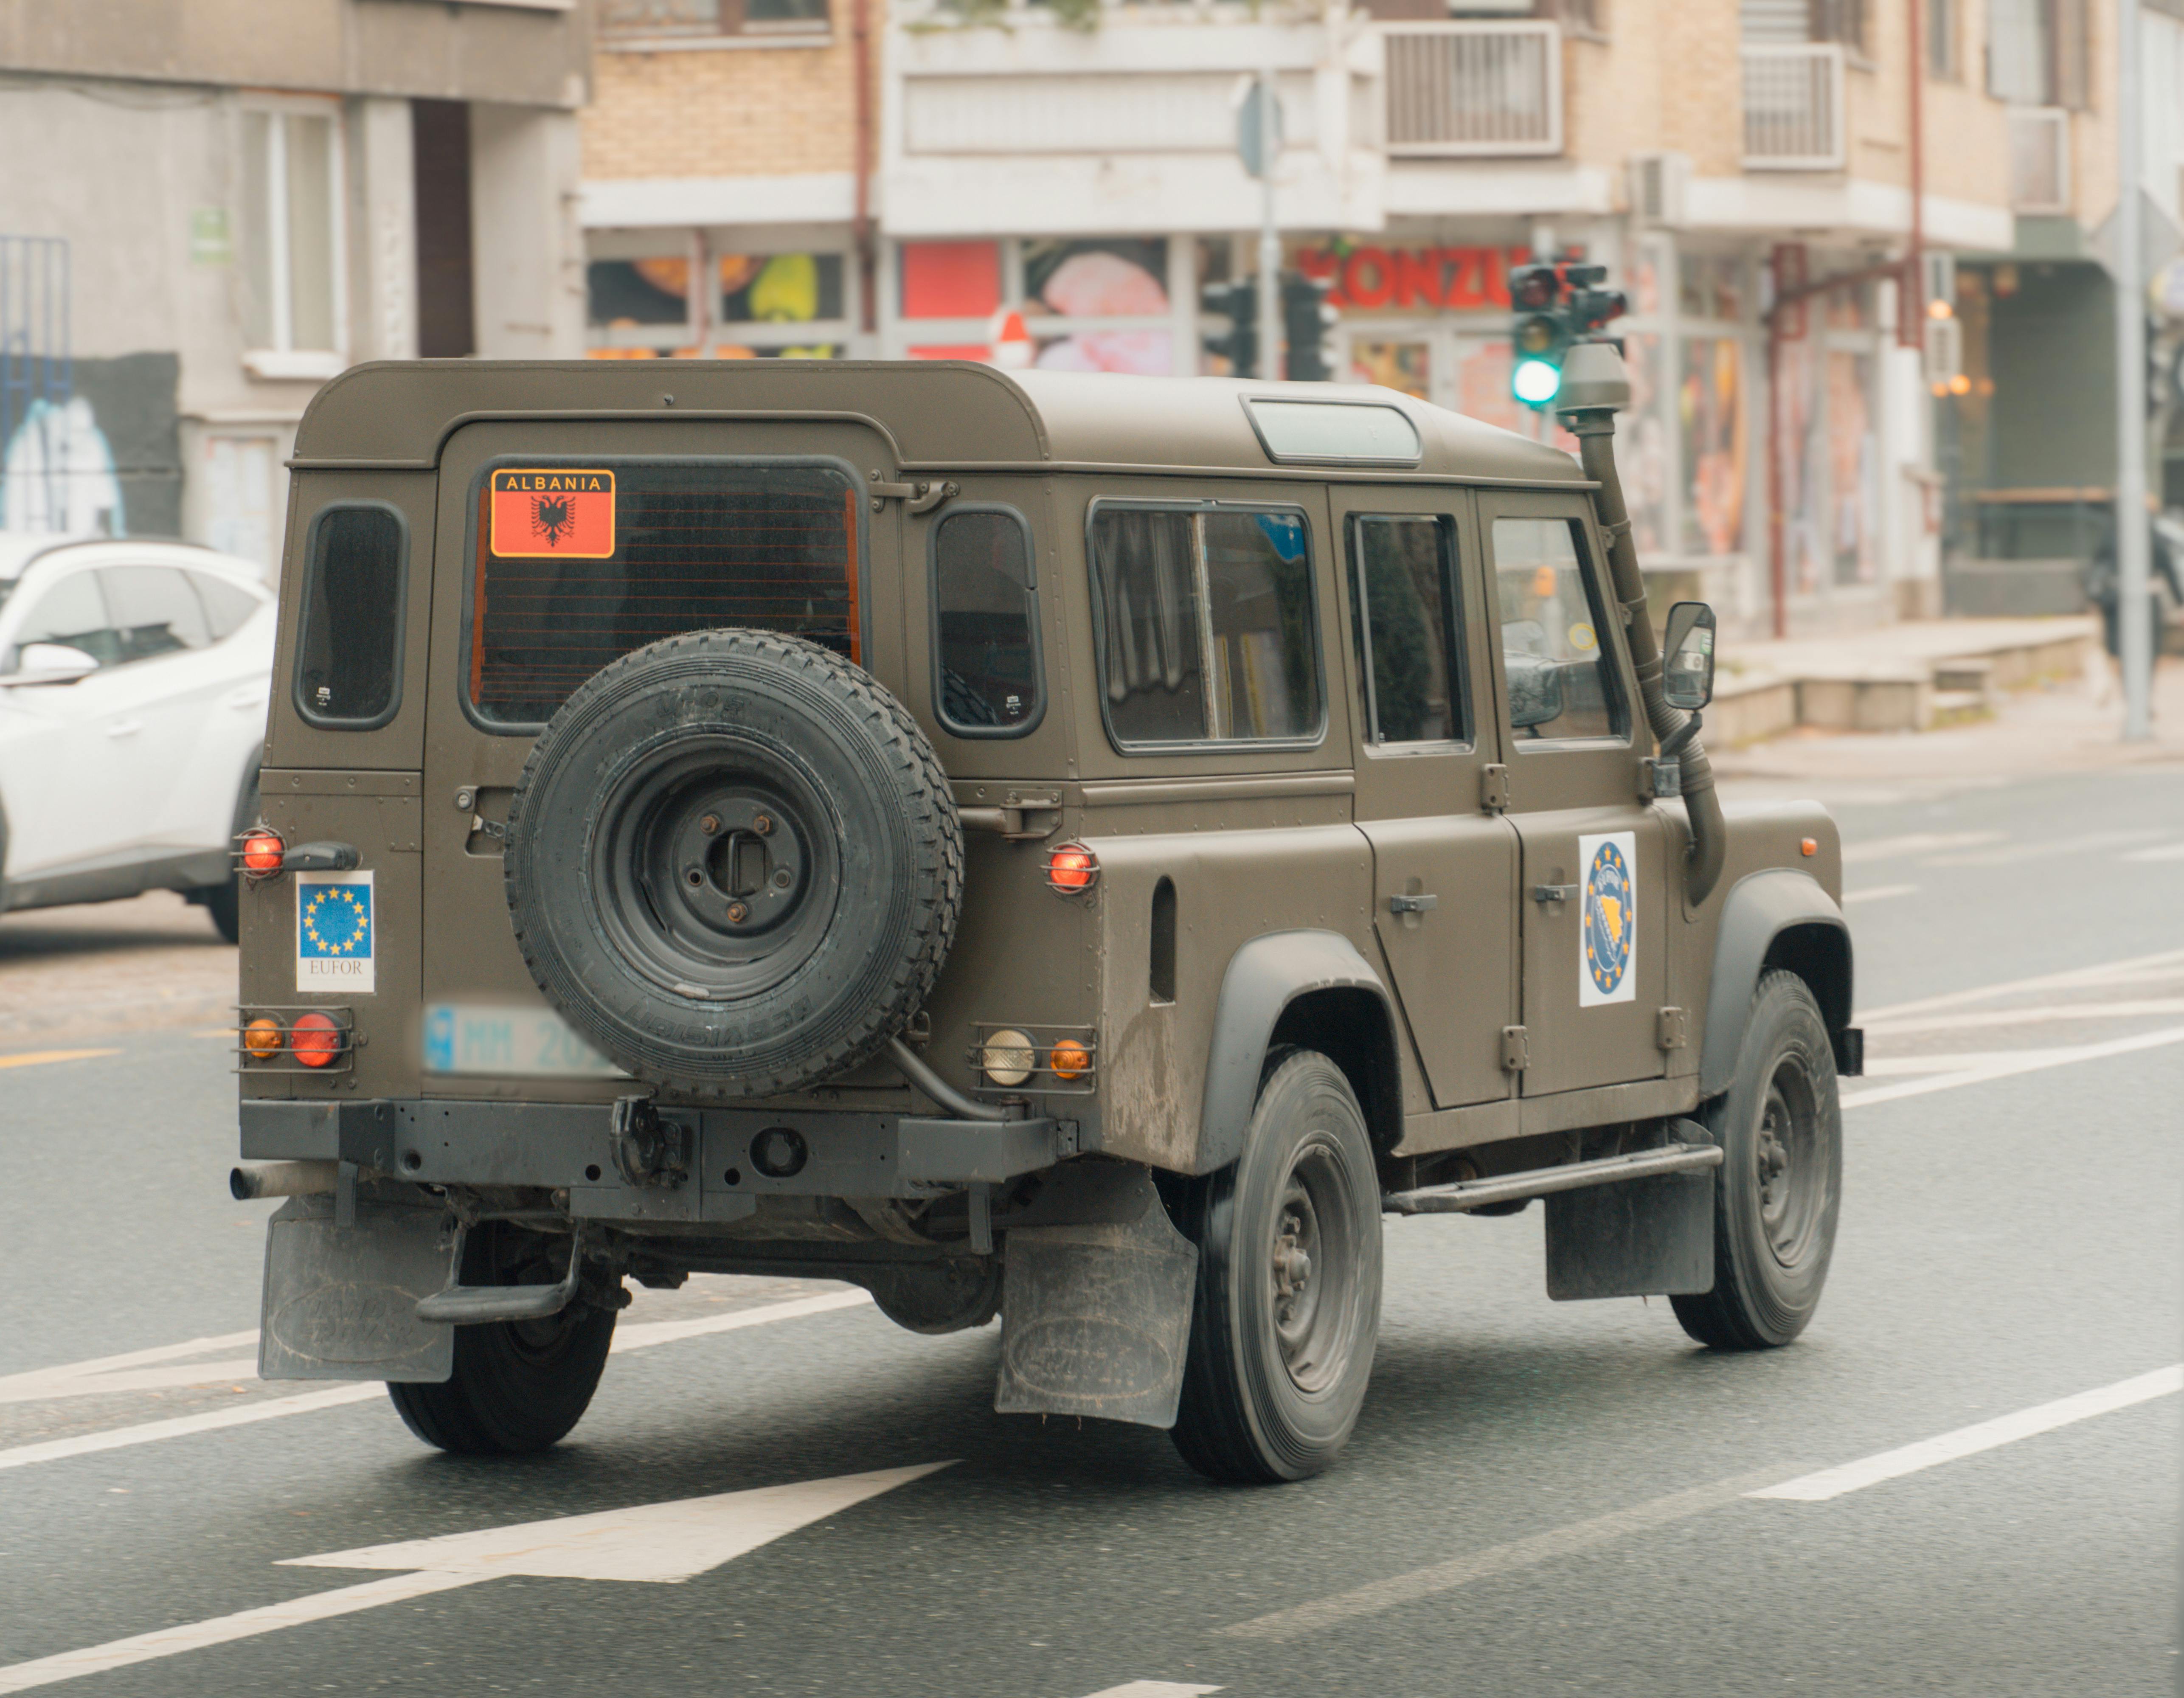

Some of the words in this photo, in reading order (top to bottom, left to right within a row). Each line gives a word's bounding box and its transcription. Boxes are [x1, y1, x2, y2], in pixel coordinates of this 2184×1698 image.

[1297, 244, 1585, 310] KONZU
[506, 477, 601, 490] ALBANIA
[310, 960, 362, 974] EUFOR
